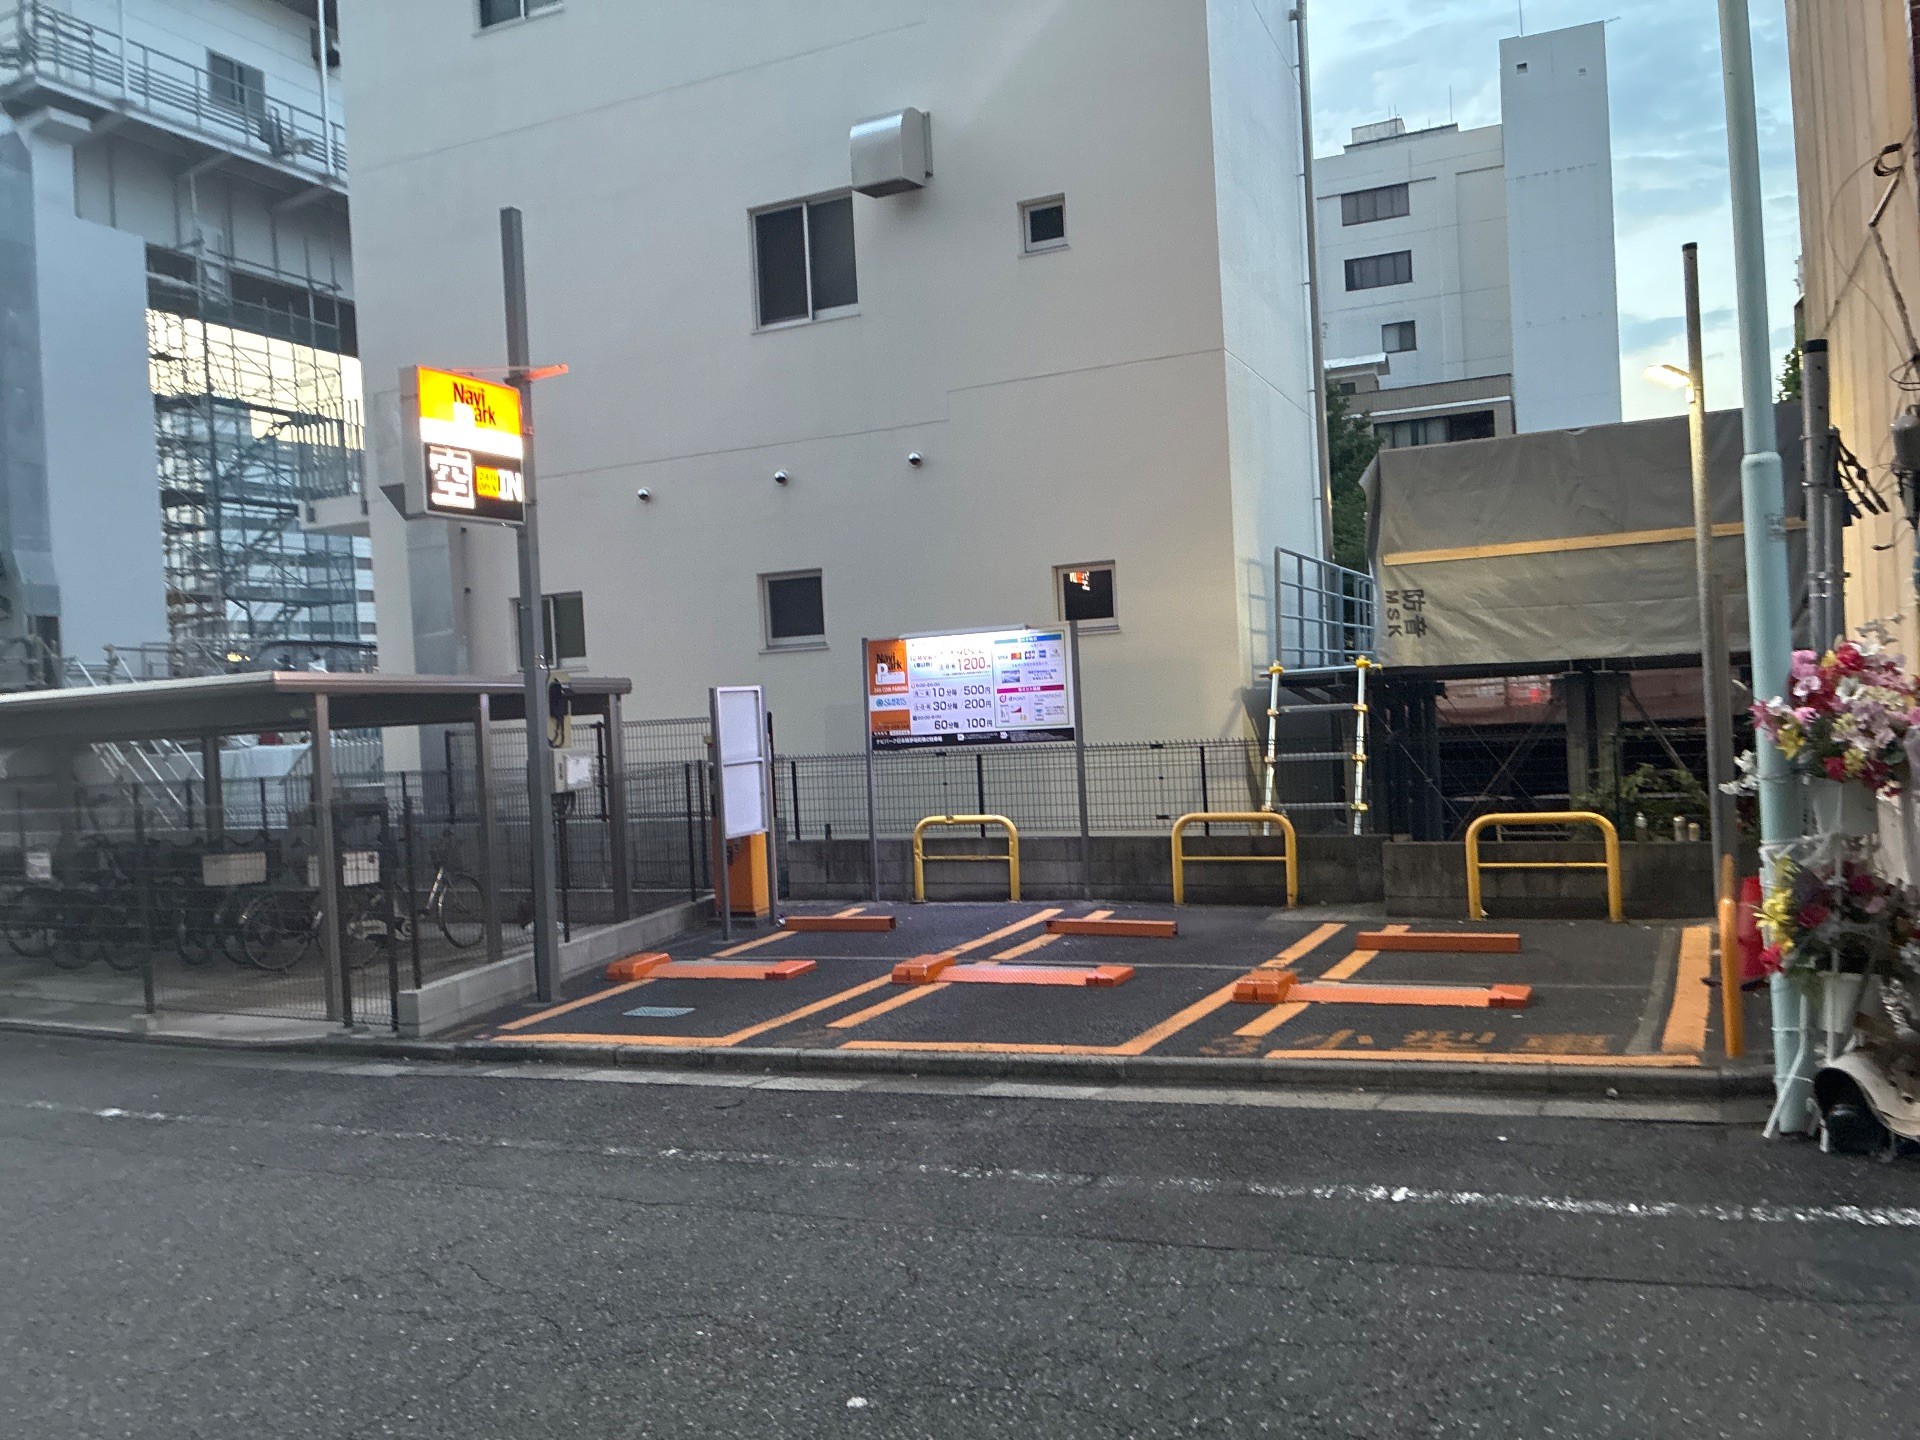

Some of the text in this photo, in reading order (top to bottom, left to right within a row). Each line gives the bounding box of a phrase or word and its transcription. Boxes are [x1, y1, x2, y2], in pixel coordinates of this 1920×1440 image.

[452, 381, 486, 406] Navi
[429, 445, 474, 509] 空
[1385, 590, 1403, 637] MSK
[1401, 589, 1428, 638] 防音
[876, 652, 895, 664] Navi
